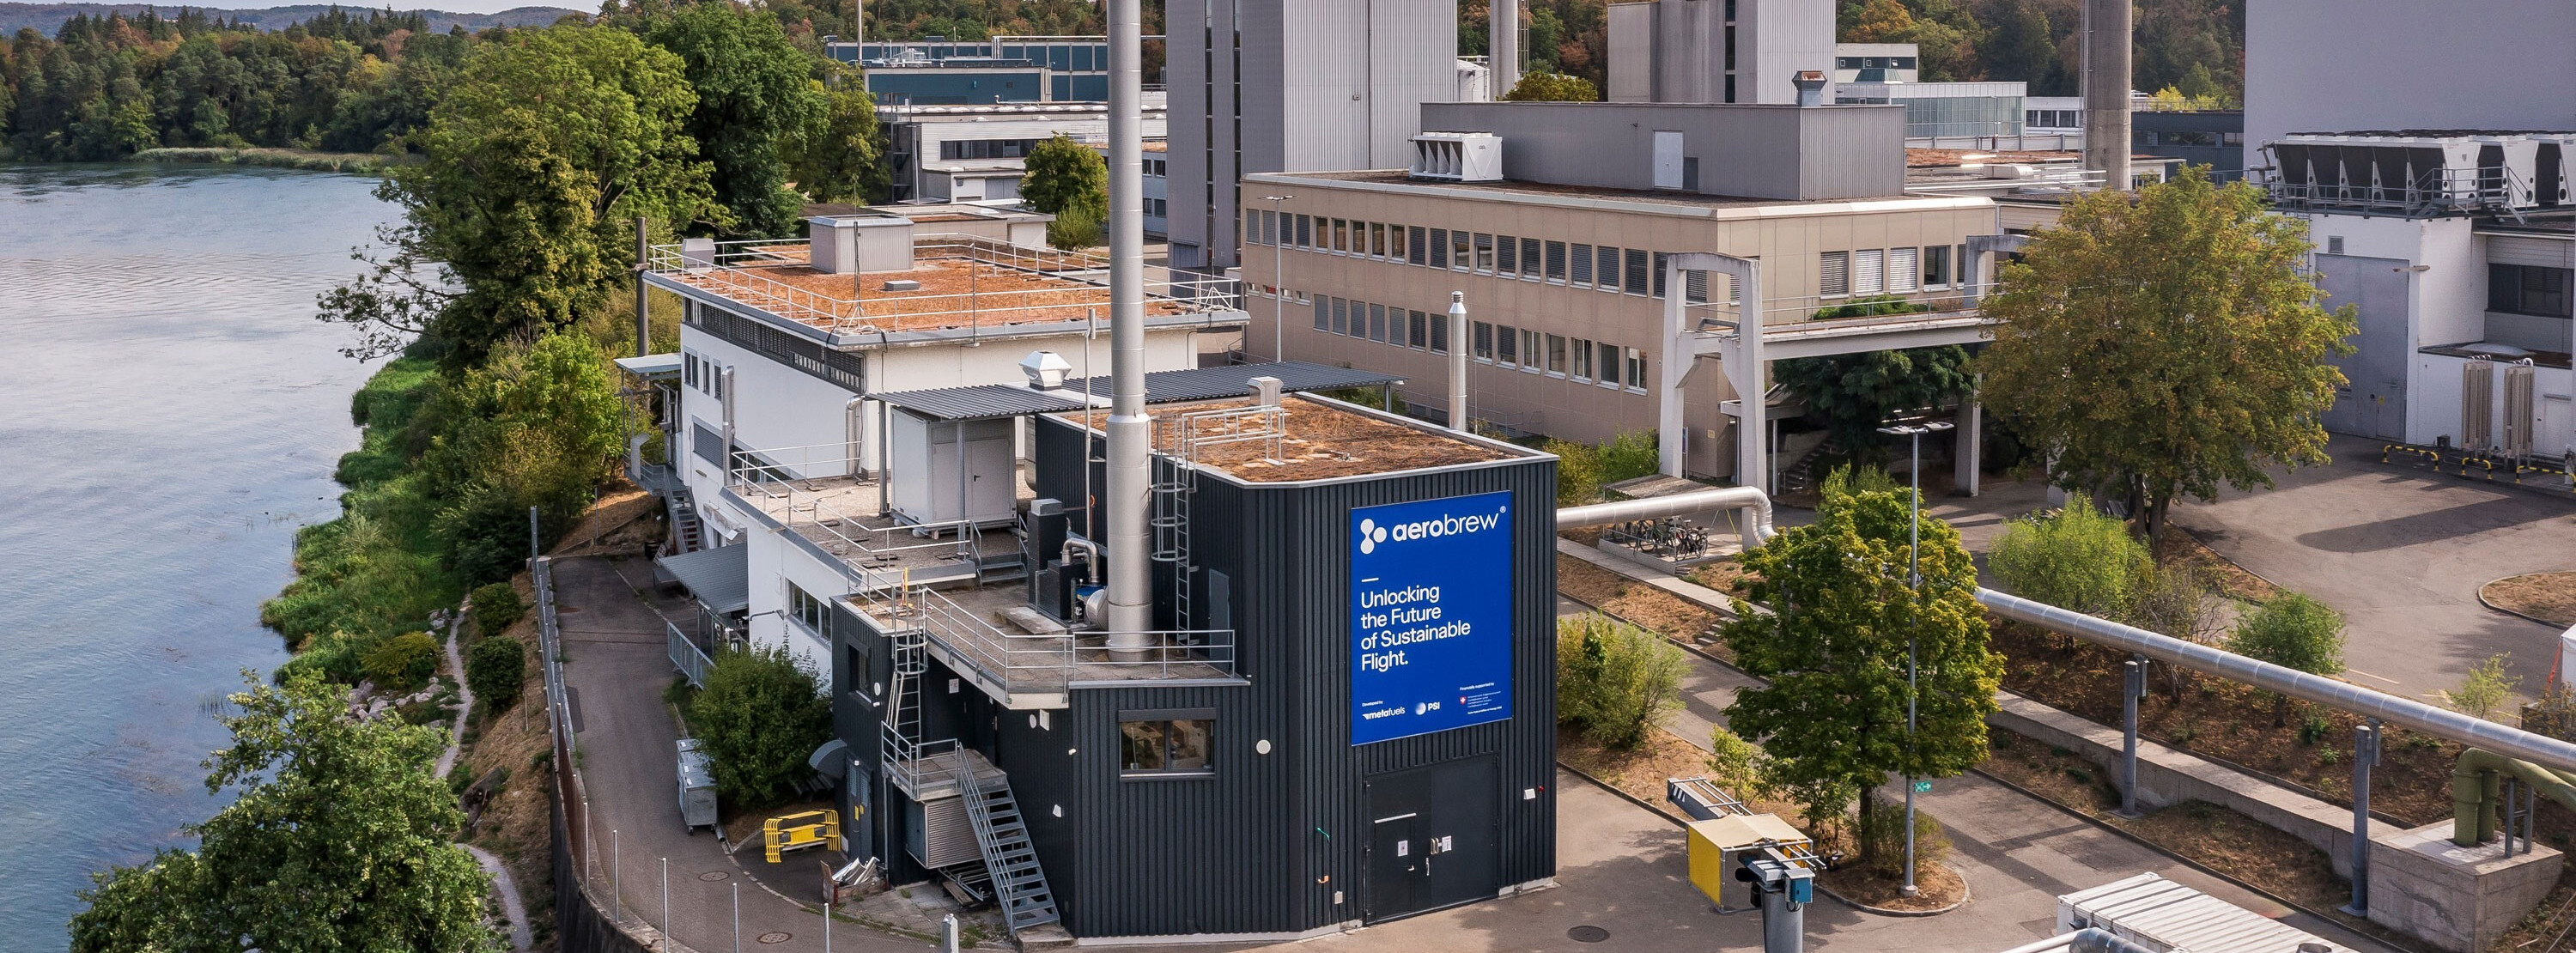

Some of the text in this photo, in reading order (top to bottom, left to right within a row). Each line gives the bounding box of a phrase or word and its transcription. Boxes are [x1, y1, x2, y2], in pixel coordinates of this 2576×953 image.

[1361, 585, 1440, 609] Unlocking
[1360, 606, 1442, 628] the Future
[1361, 619, 1471, 650] of Sustainable
[1361, 650, 1408, 672] Flight.
[1427, 701, 1440, 711] PSI
